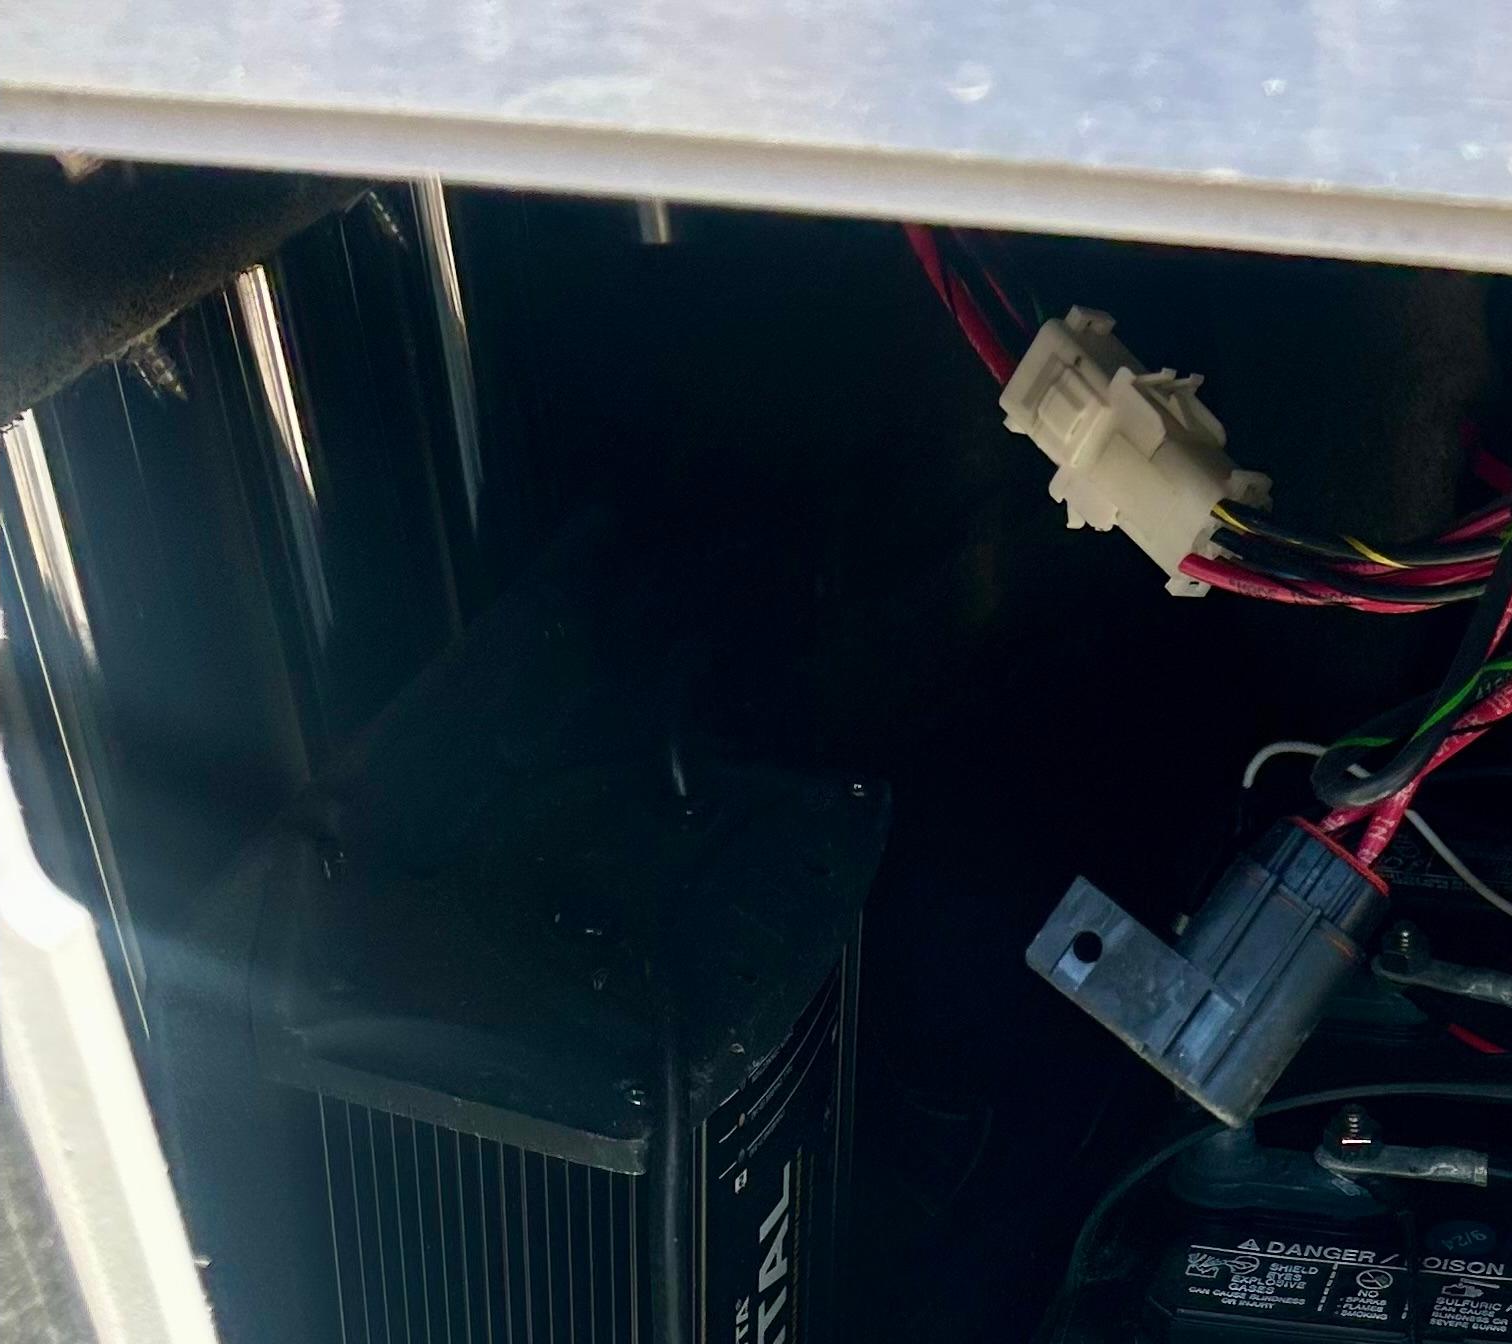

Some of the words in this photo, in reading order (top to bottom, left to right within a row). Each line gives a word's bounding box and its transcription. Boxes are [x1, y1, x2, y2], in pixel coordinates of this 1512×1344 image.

[1267, 1241, 1376, 1263] DANGER
[1404, 1254, 1506, 1276] OISON
[1269, 1262, 1319, 1275] SHIELD
[1231, 1274, 1307, 1289] EXPLOSIVE
[1266, 1271, 1302, 1282] EYES
[1228, 1283, 1274, 1295] GASES
[1358, 1289, 1379, 1298] NO
[1436, 1297, 1502, 1311] SULFURIC
